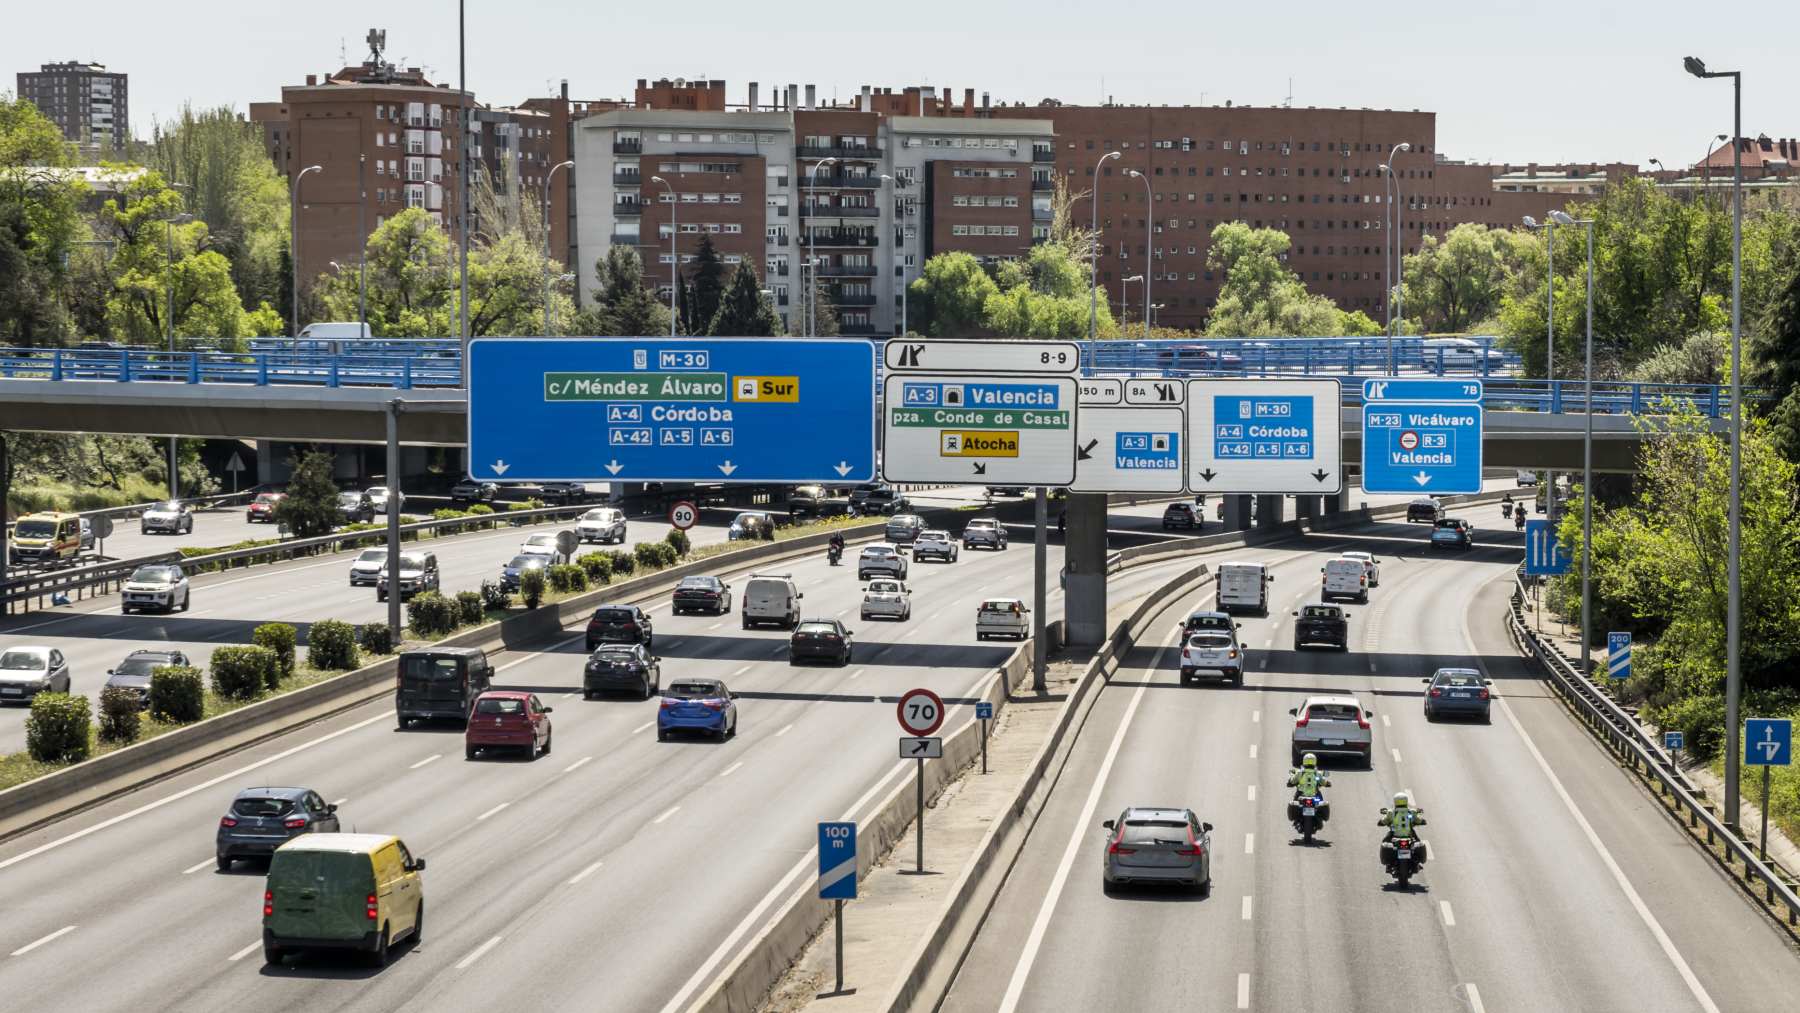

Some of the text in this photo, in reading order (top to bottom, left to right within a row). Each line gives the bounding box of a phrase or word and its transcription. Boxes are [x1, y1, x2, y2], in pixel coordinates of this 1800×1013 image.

[662, 353, 706, 367] M-30
[1041, 352, 1067, 364] 8-9
[661, 375, 723, 396] Álvaro
[762, 381, 794, 397] Sur
[1132, 388, 1146, 396] 8A
[1463, 385, 1478, 395] 7B
[908, 388, 1055, 406] A-3 Valencia
[610, 405, 733, 422] A-4 Córdoba
[1258, 404, 1289, 415] M-30
[893, 411, 1068, 426] pza. Conde de Casal
[1370, 412, 1474, 427] M-23 Vicálvaro
[612, 431, 730, 444] A-42 A-5 A-6
[1219, 425, 1308, 438] A-4 Córdoba
[963, 436, 1017, 452] Atocha
[1124, 437, 1145, 447] A-3
[1424, 436, 1444, 446] R-3
[1221, 445, 1307, 455] A-42 A-5 A-6
[1117, 456, 1177, 469] Valencia
[1392, 452, 1452, 465] Valencia
[675, 511, 692, 521] 90
[1611, 635, 1629, 643] 200
[908, 704, 935, 721] 70
[825, 827, 850, 838] 100
[832, 840, 844, 848] m
